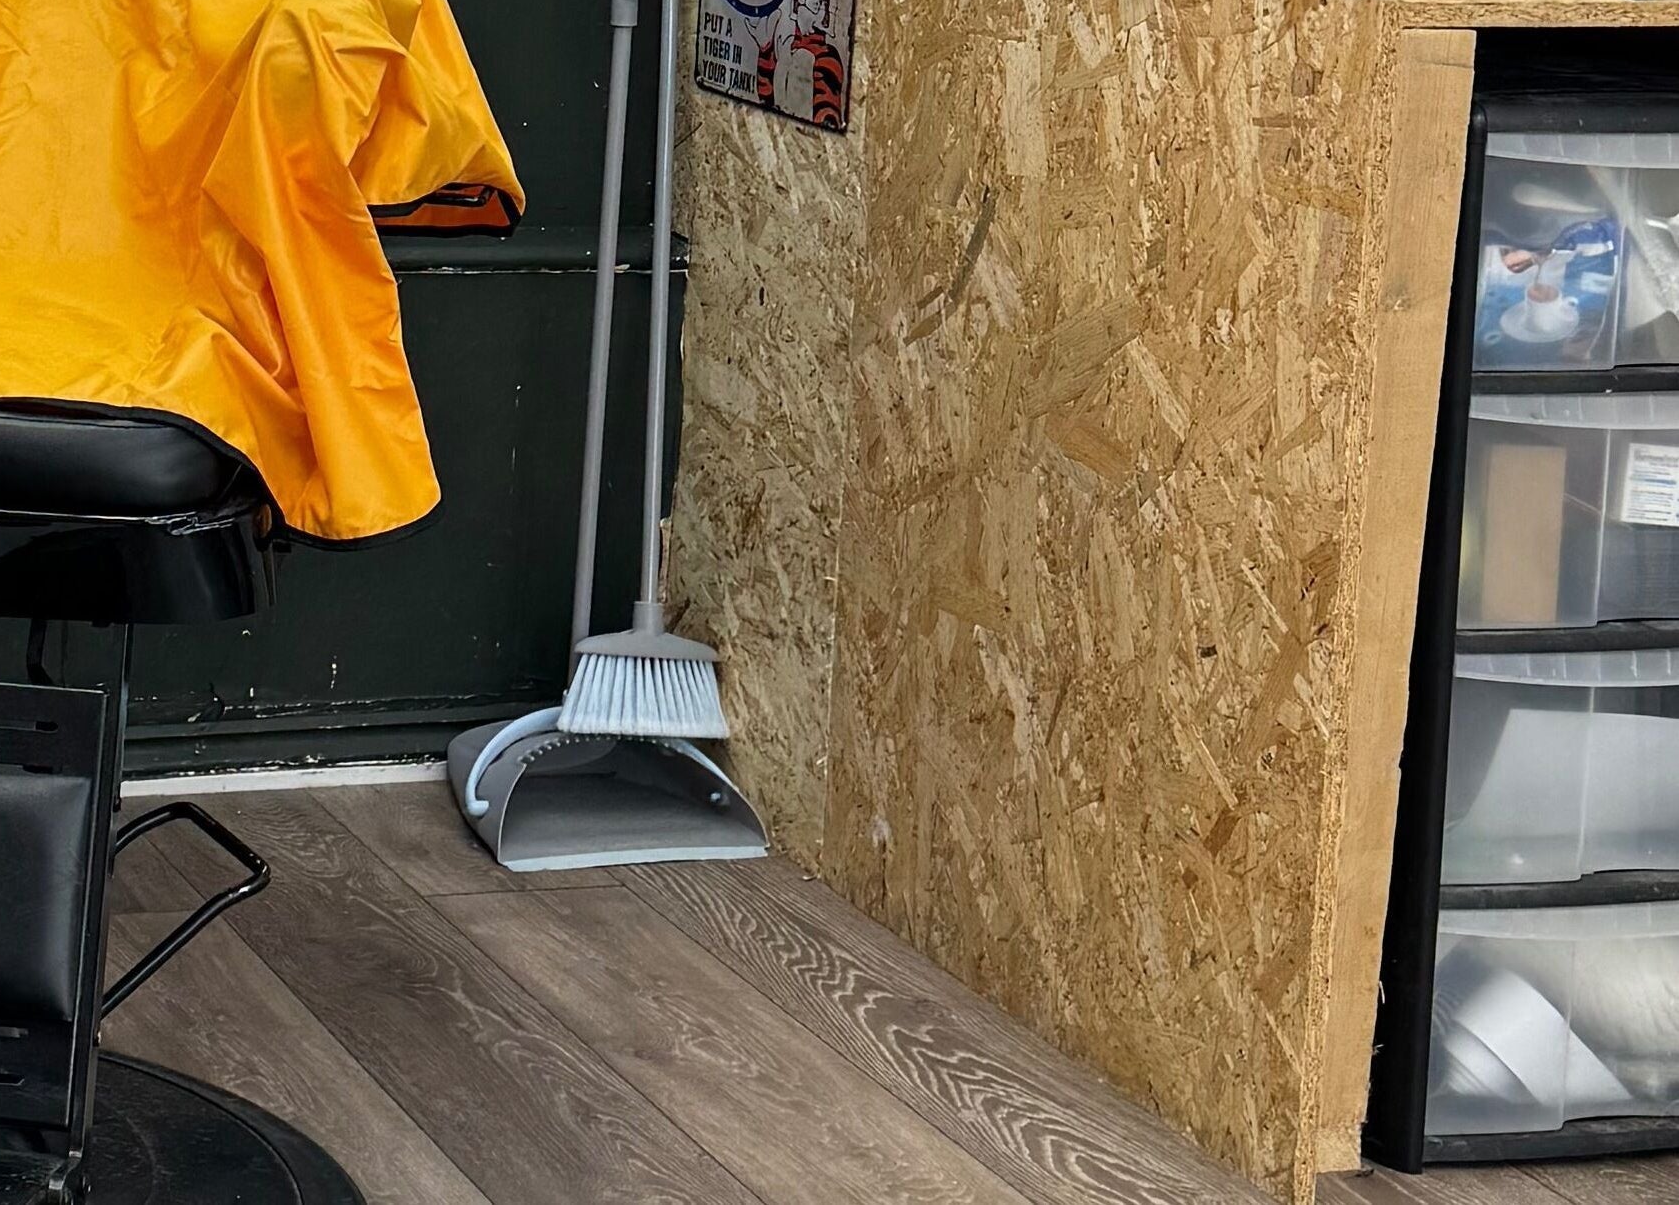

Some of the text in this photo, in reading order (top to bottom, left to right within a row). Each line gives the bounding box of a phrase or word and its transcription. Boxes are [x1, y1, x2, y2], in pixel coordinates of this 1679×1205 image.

[703, 11, 732, 38] PUT A
[703, 35, 742, 65] TIGER IN
[702, 58, 756, 94] YOUR TANK!
